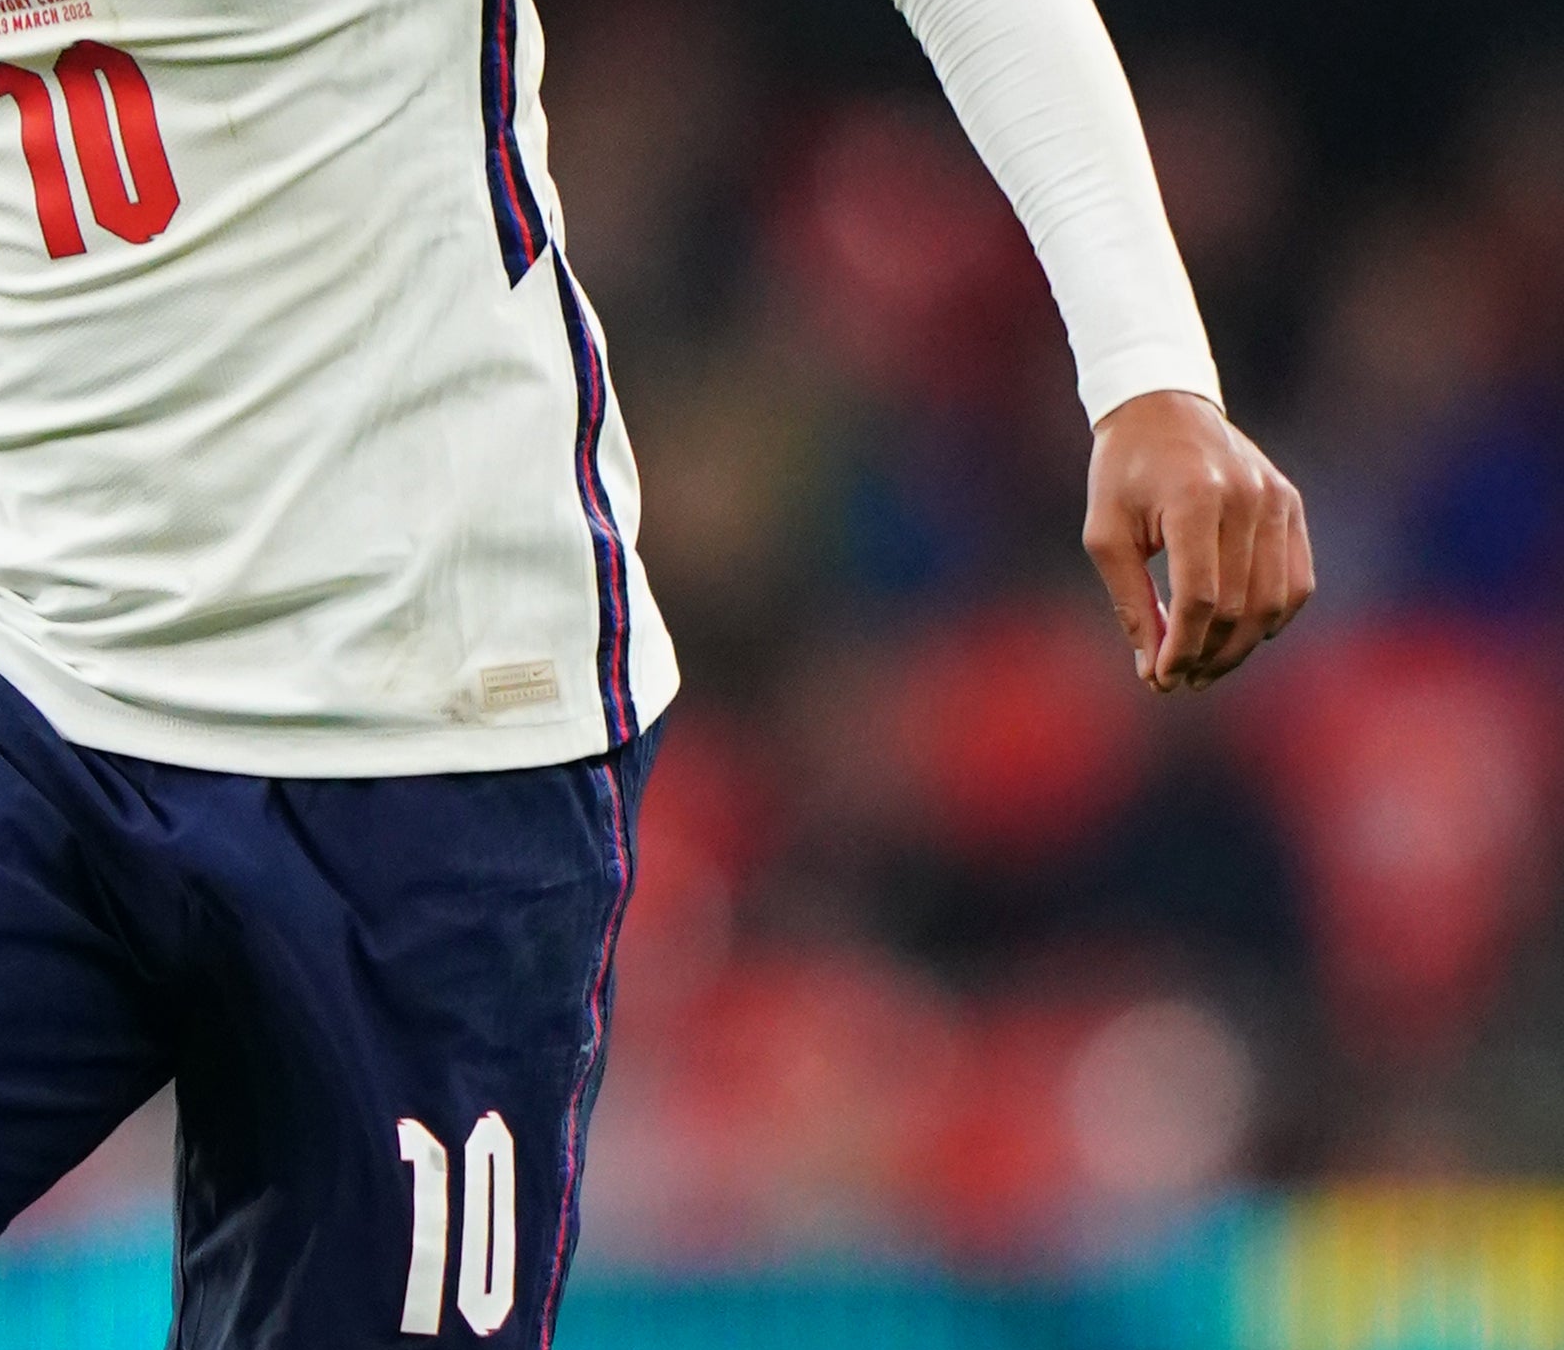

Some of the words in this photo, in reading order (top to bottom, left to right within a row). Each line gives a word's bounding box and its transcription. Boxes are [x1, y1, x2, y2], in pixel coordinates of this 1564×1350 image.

[12, 7, 60, 32] MARCH
[61, 0, 93, 22] 2022
[396, 1109, 516, 1337] 10
